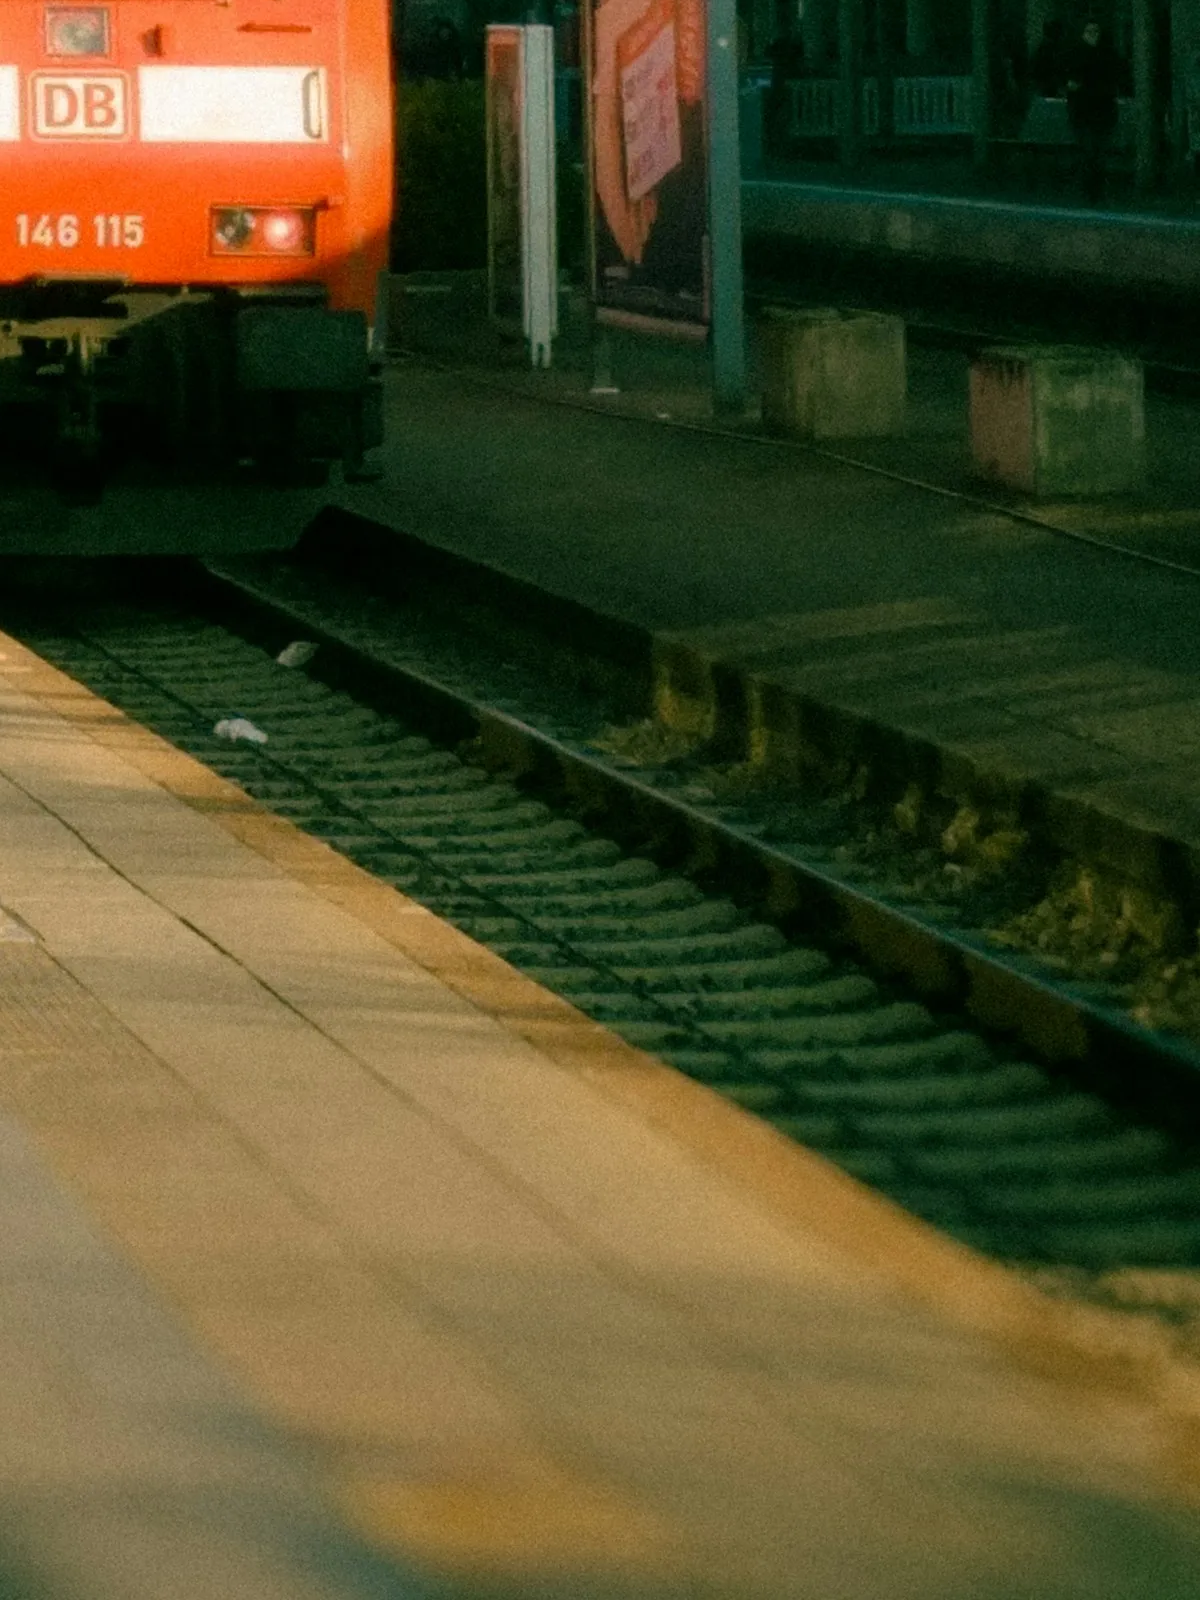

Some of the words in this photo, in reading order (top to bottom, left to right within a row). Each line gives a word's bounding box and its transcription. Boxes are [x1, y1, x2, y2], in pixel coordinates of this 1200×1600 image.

[45, 83, 117, 128] DB
[16, 213, 80, 248] 146
[93, 213, 145, 248] 115
